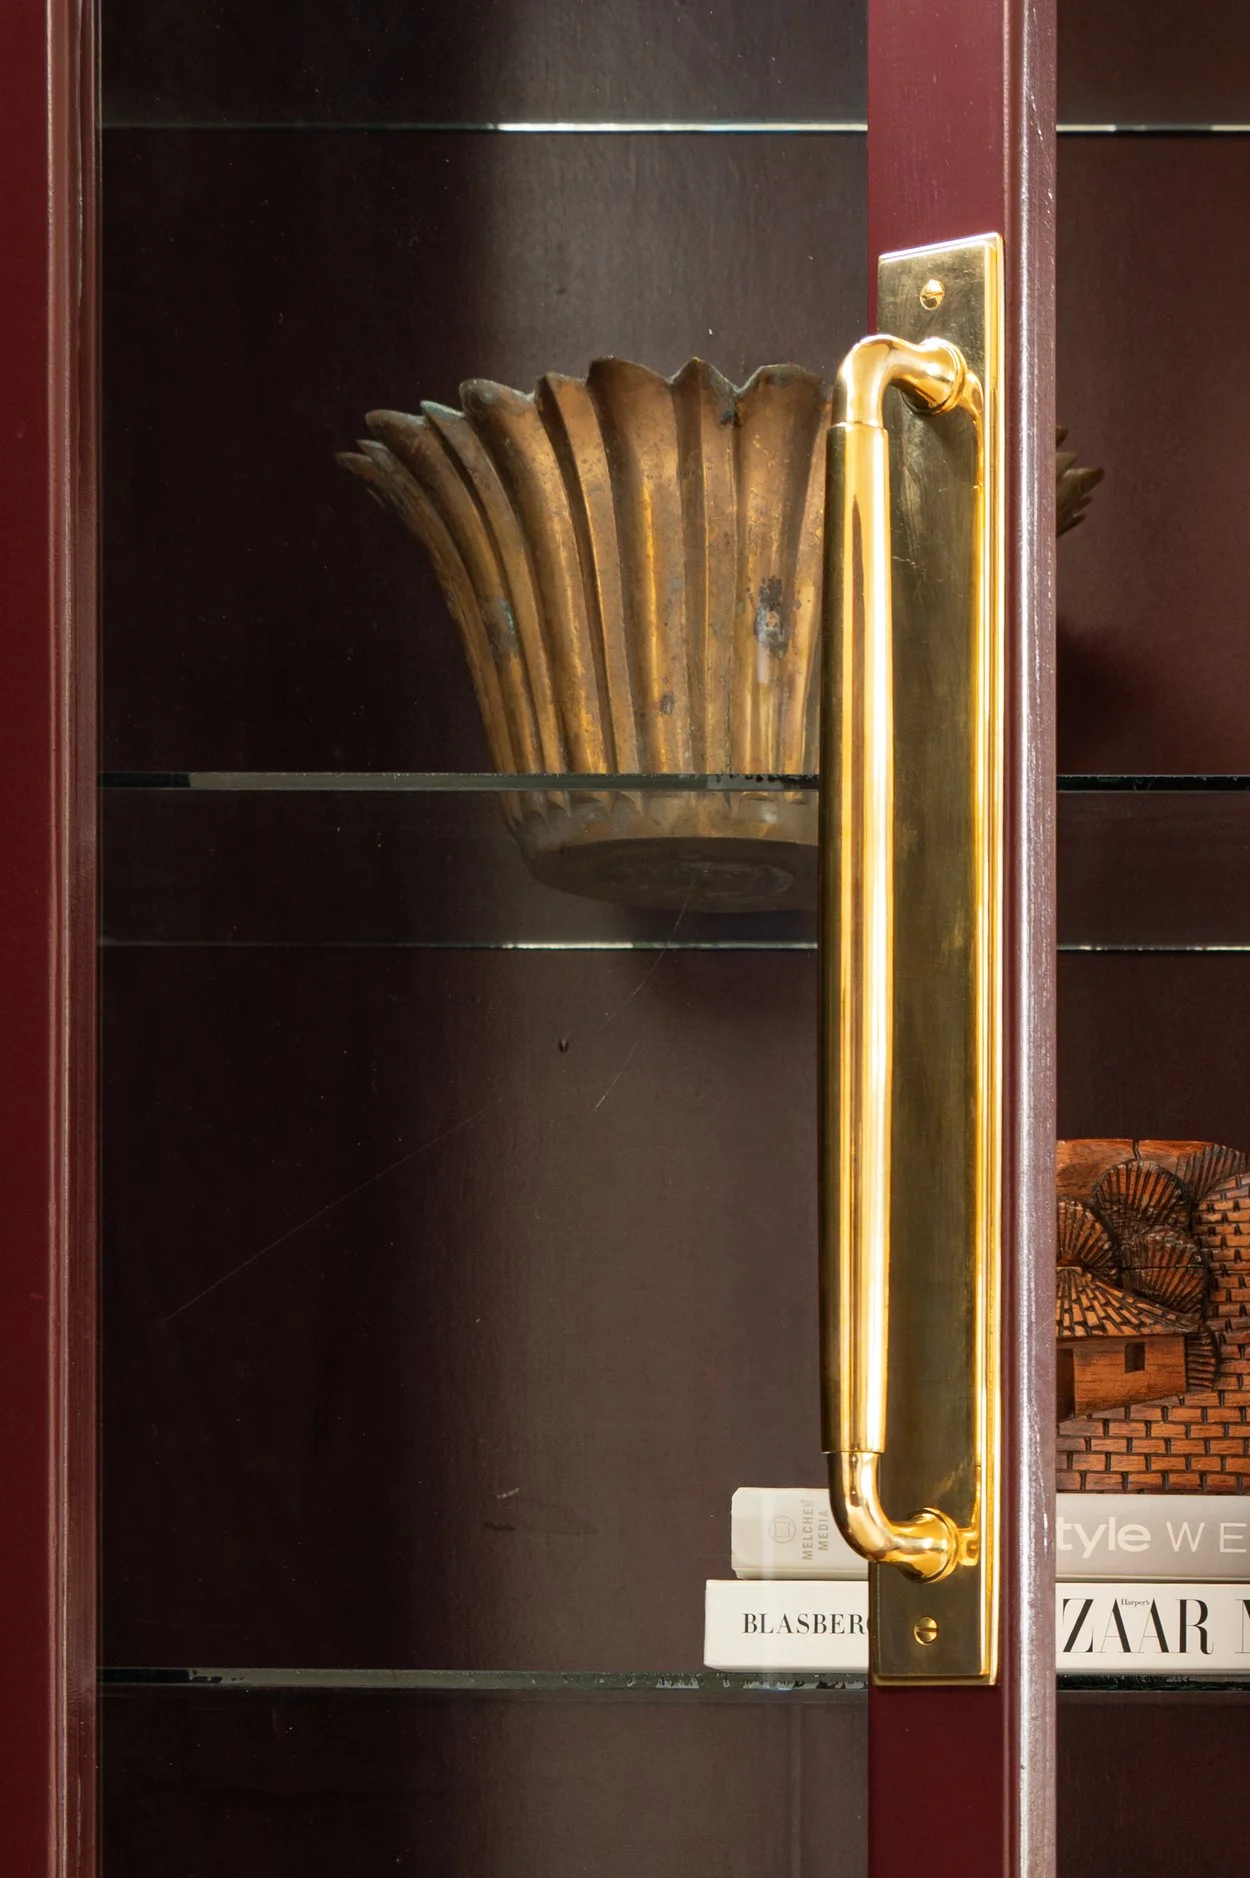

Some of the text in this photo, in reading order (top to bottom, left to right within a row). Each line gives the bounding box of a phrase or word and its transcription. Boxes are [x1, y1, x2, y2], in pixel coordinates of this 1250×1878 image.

[818, 1509, 829, 1551] MEDIA
[1056, 1516, 1151, 1558] tyle
[742, 1612, 869, 1635] BLASBER
[1057, 1598, 1215, 1655] ZAAR
